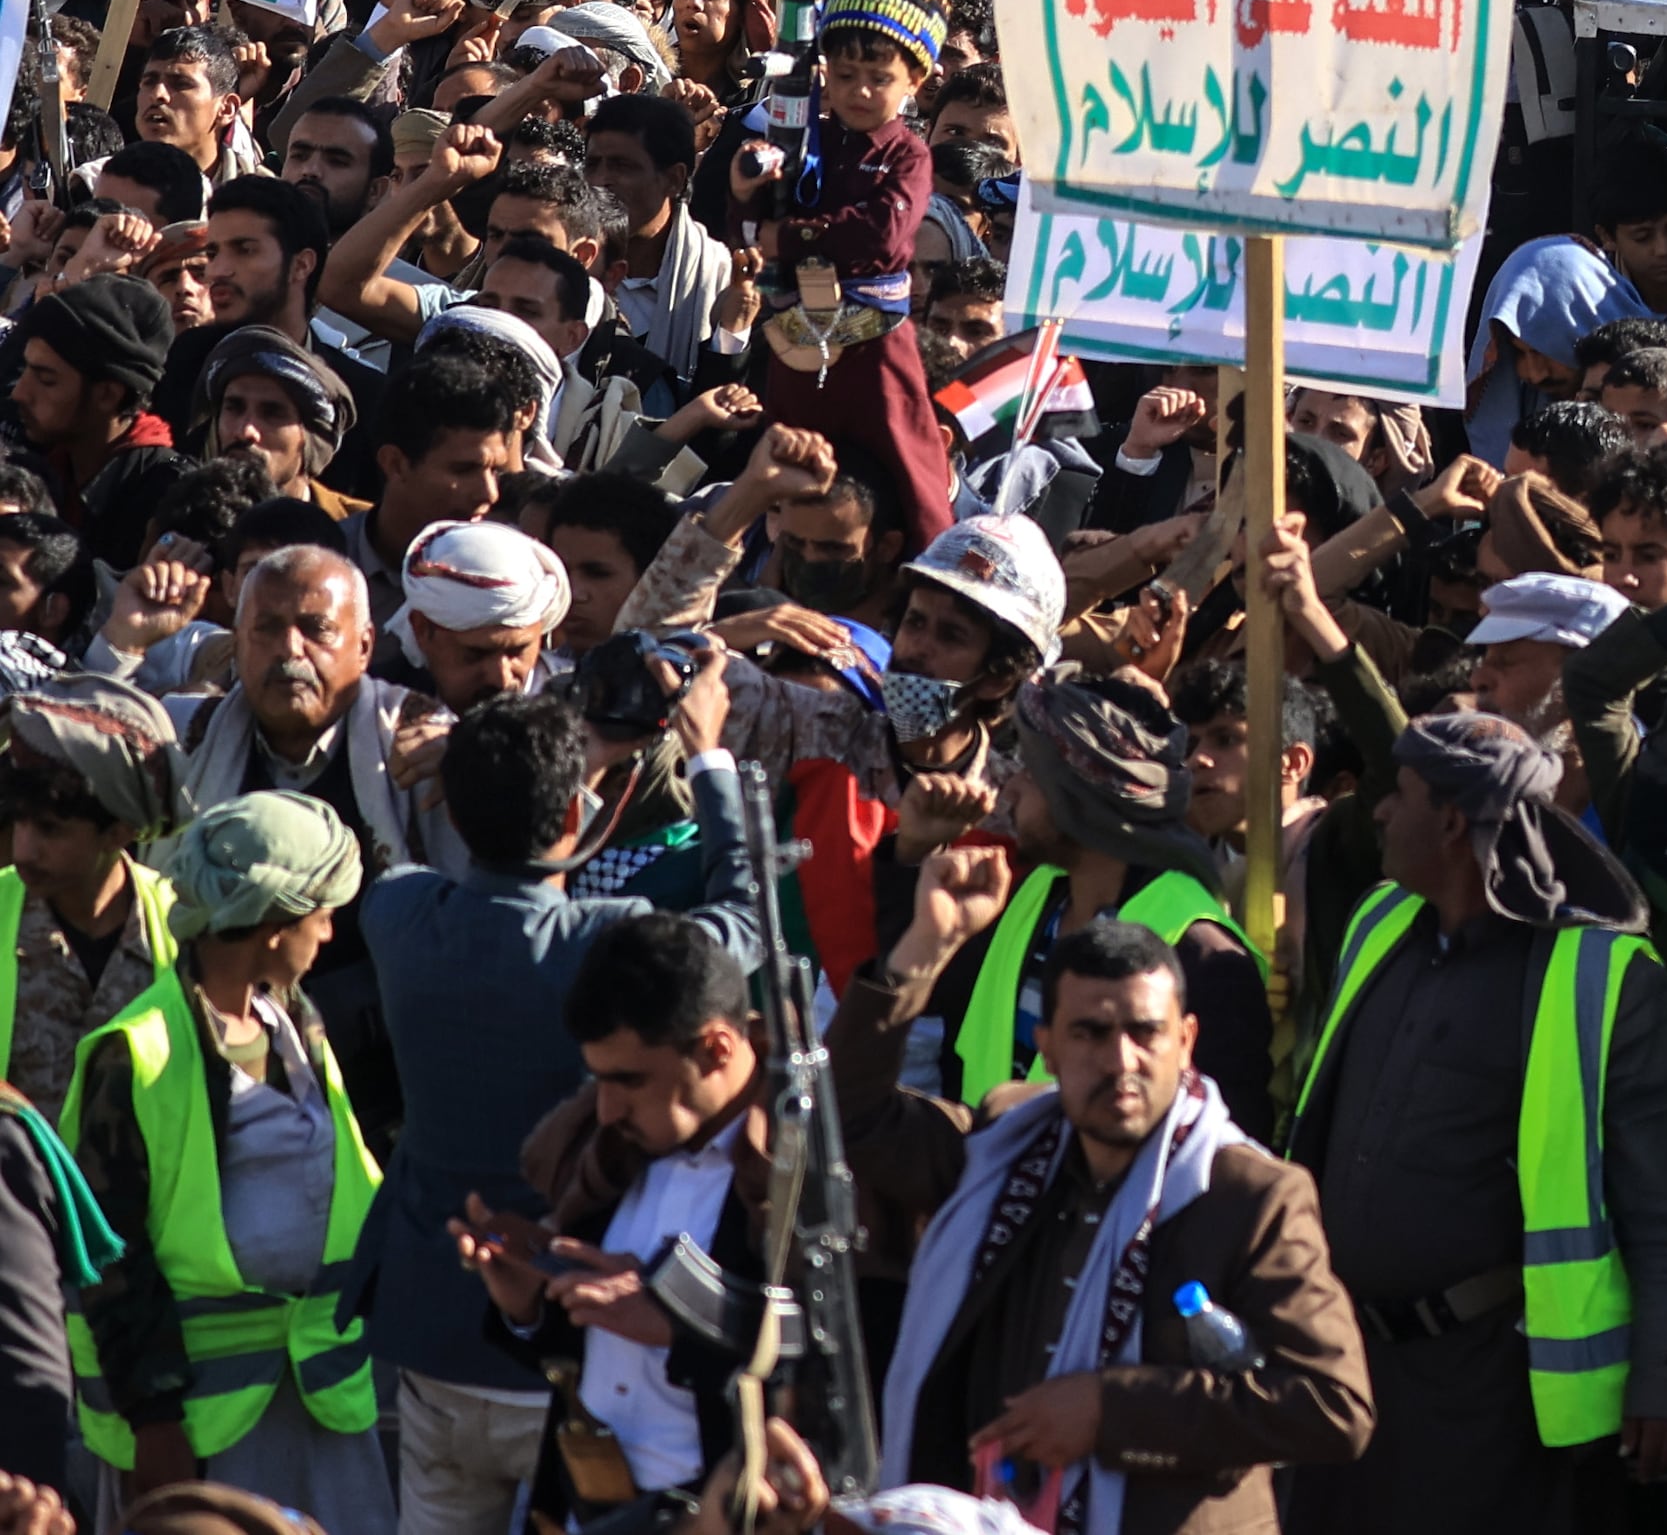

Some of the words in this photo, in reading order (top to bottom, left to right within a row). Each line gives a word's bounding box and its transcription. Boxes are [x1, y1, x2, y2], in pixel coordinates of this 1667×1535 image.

[1084, 62, 1268, 196] للإسلام
[1278, 80, 1453, 198] النصر
[1051, 217, 1242, 339] للإسلام
